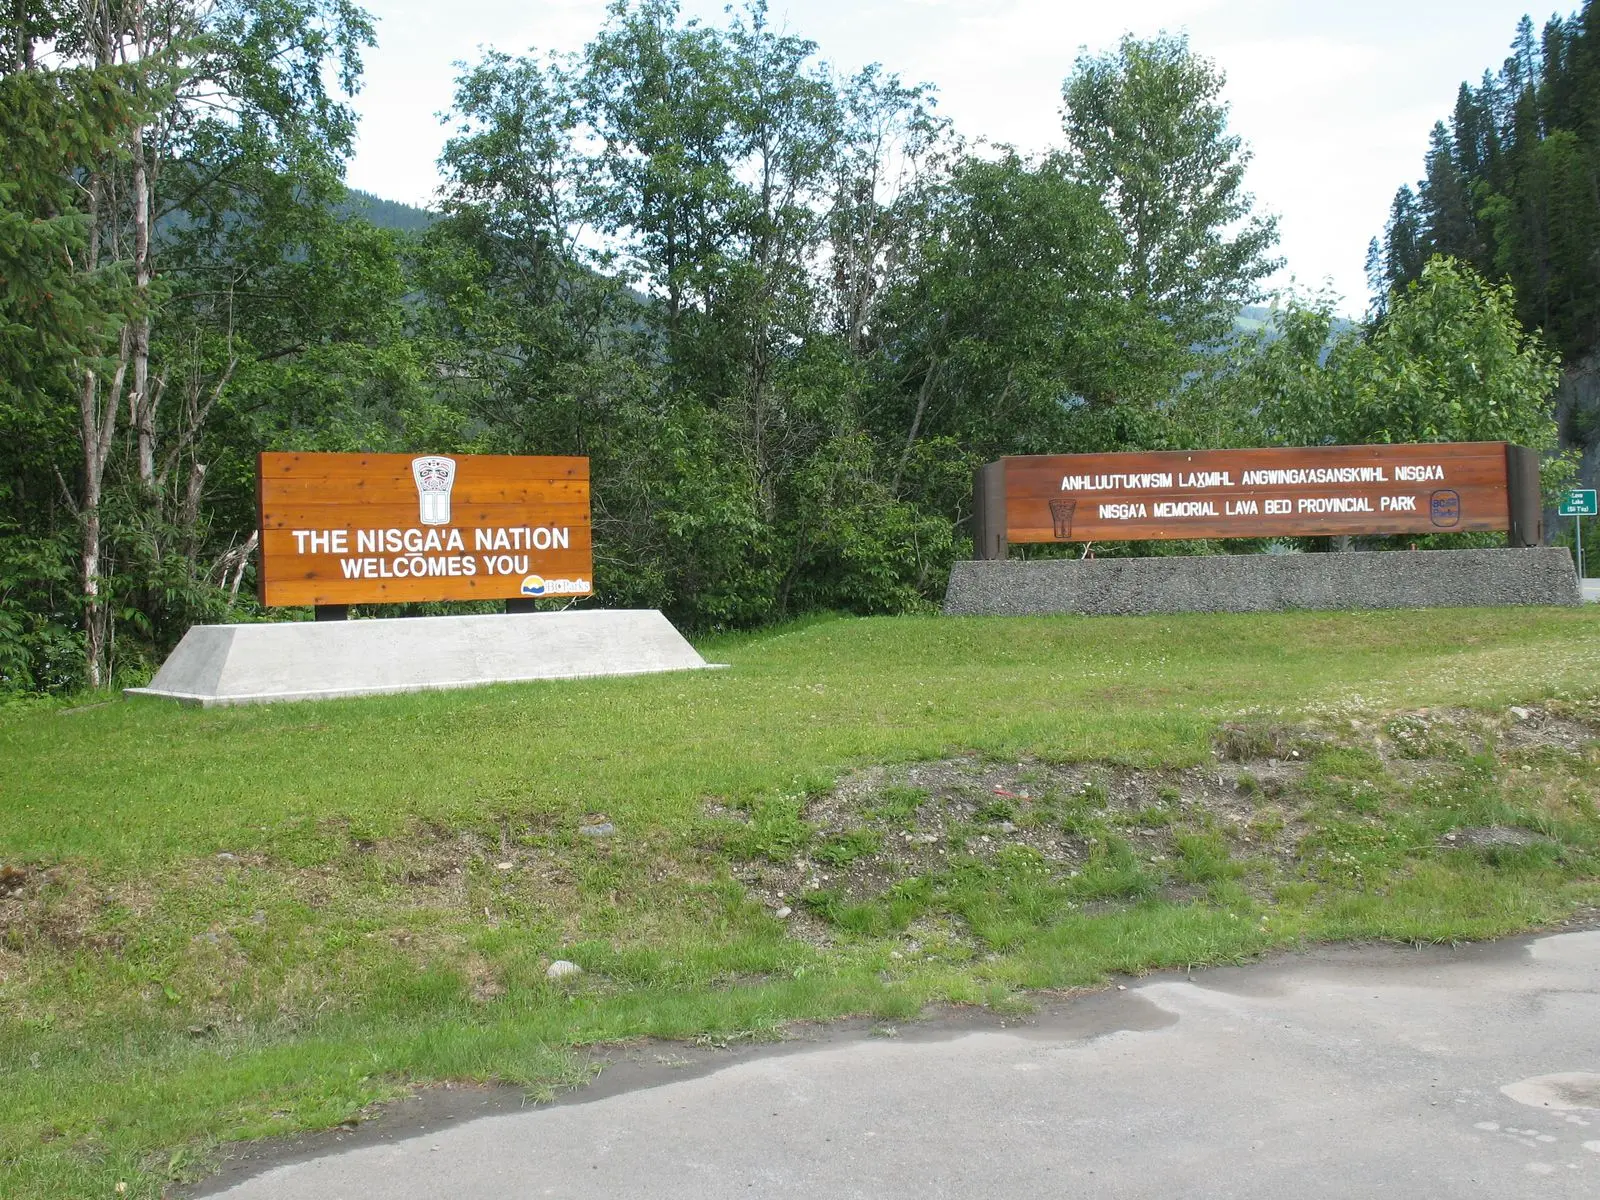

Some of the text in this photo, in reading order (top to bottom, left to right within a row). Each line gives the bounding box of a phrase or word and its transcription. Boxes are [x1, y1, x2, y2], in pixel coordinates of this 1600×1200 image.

[1154, 502, 1219, 517] MEMORIAL
[1226, 500, 1258, 515] LAVA
[1265, 499, 1292, 514] BED
[1298, 497, 1374, 513] PROVINCIAL
[1381, 496, 1416, 511] PARK
[292, 529, 348, 554] THE
[475, 527, 569, 550] NATION
[340, 555, 528, 579] WELCOMES YOU
